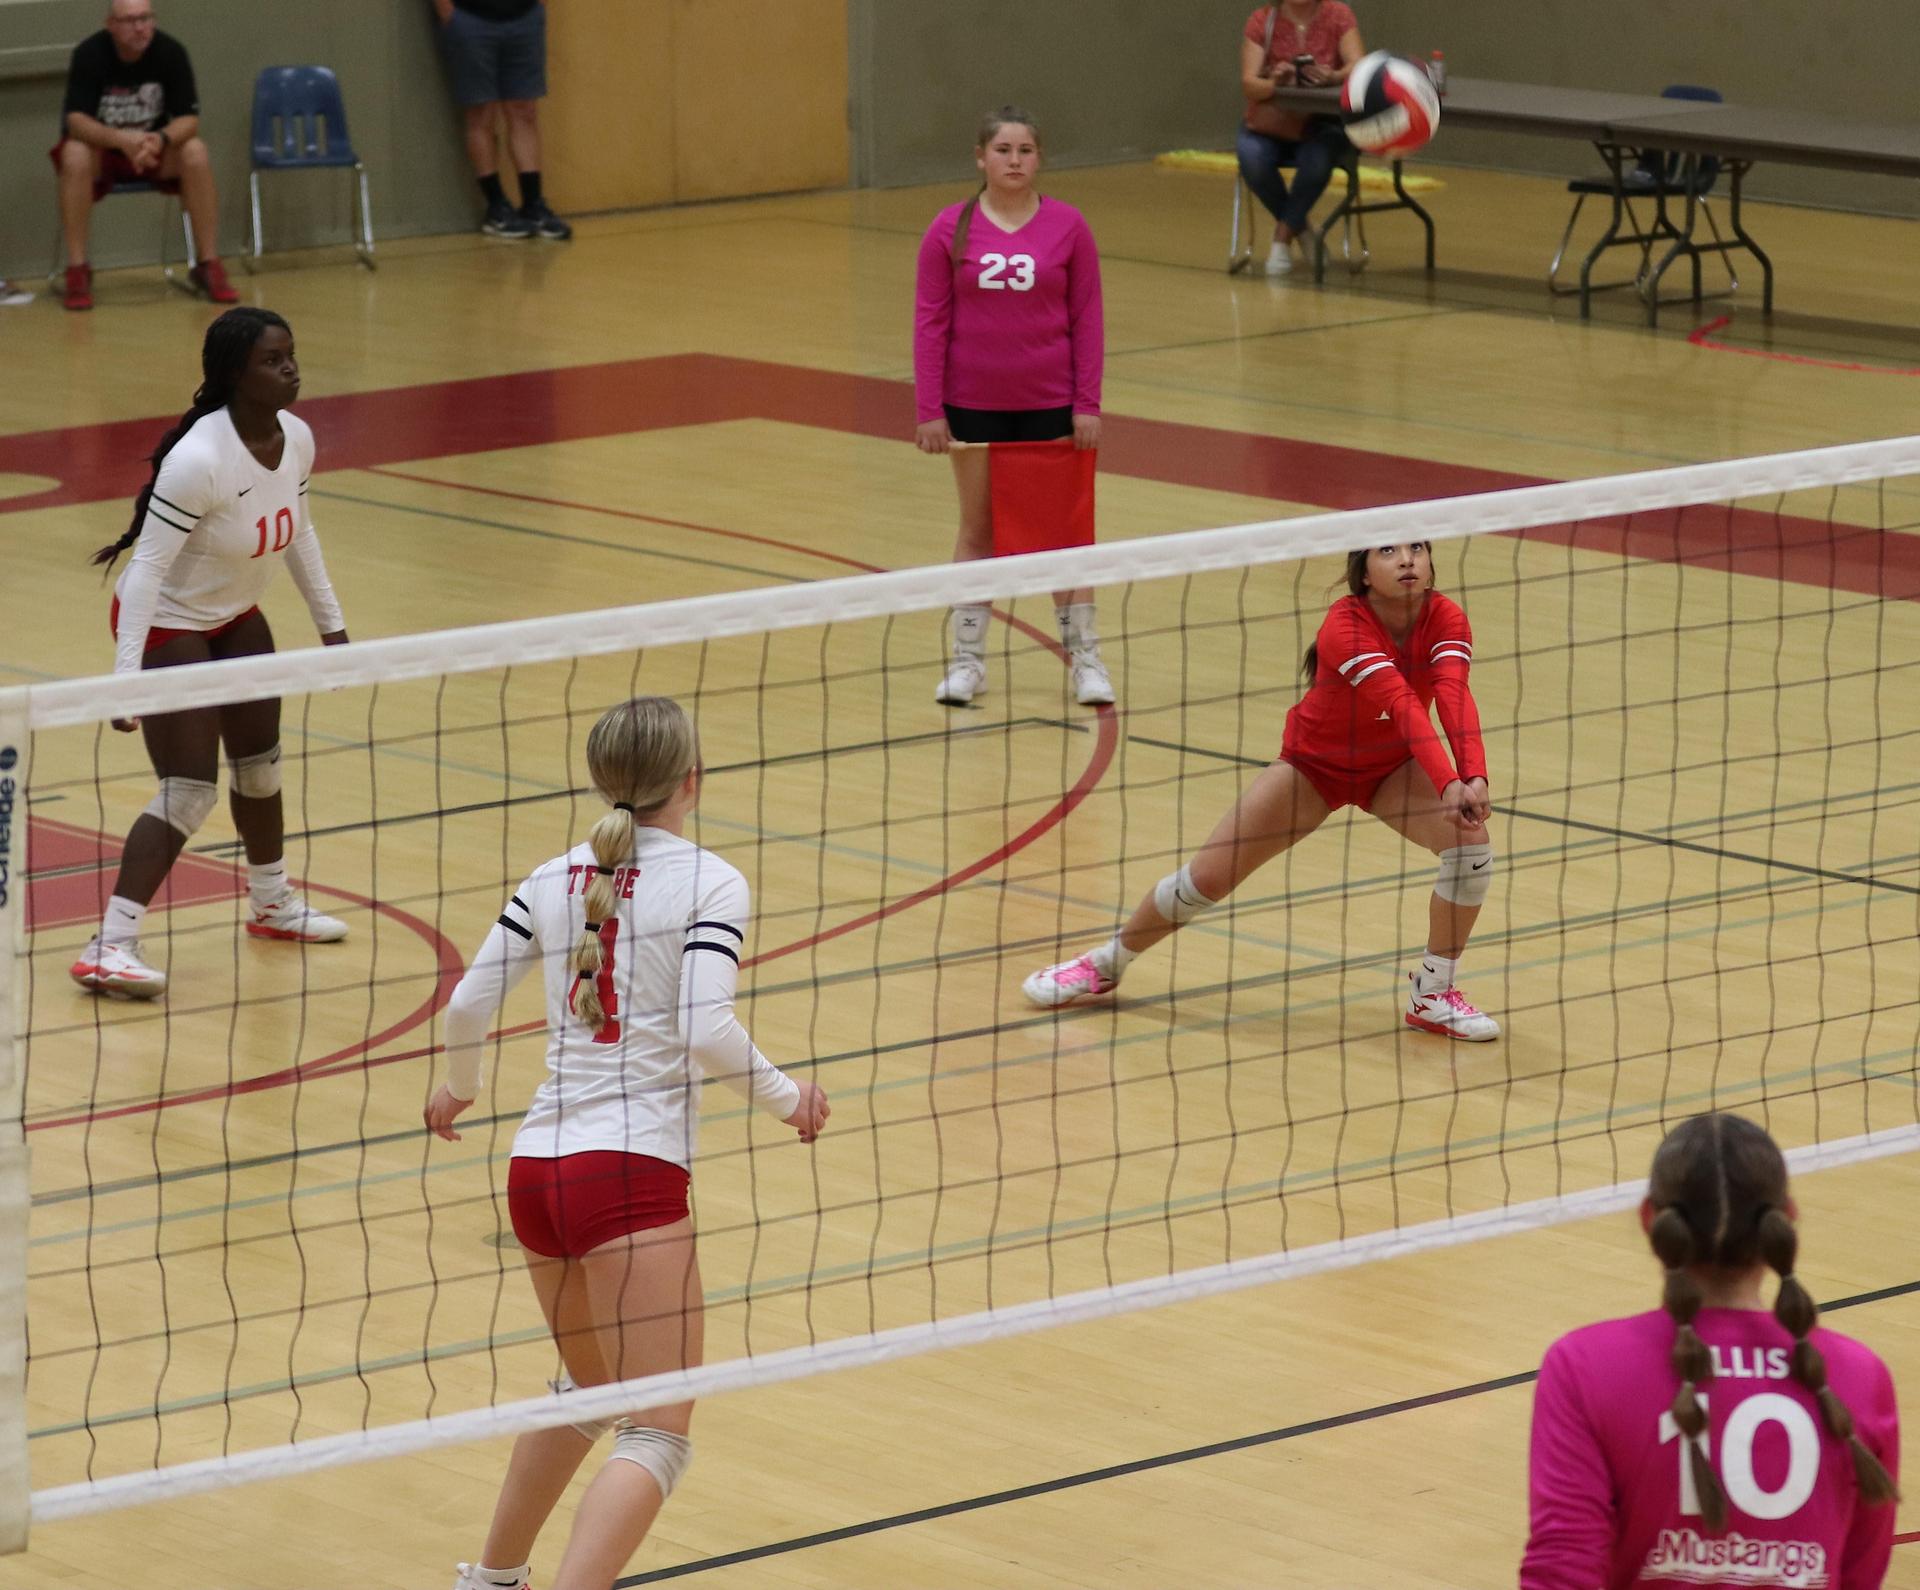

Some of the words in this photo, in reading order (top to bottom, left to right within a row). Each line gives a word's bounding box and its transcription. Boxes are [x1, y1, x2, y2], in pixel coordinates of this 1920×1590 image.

[978, 253, 1035, 291] 23
[249, 507, 293, 559] 10
[568, 865, 641, 898] TRBE
[1709, 1346, 1790, 1379] LLIS
[1659, 1392, 1821, 1520] 10
[1645, 1529, 1828, 1578] Mustangs
